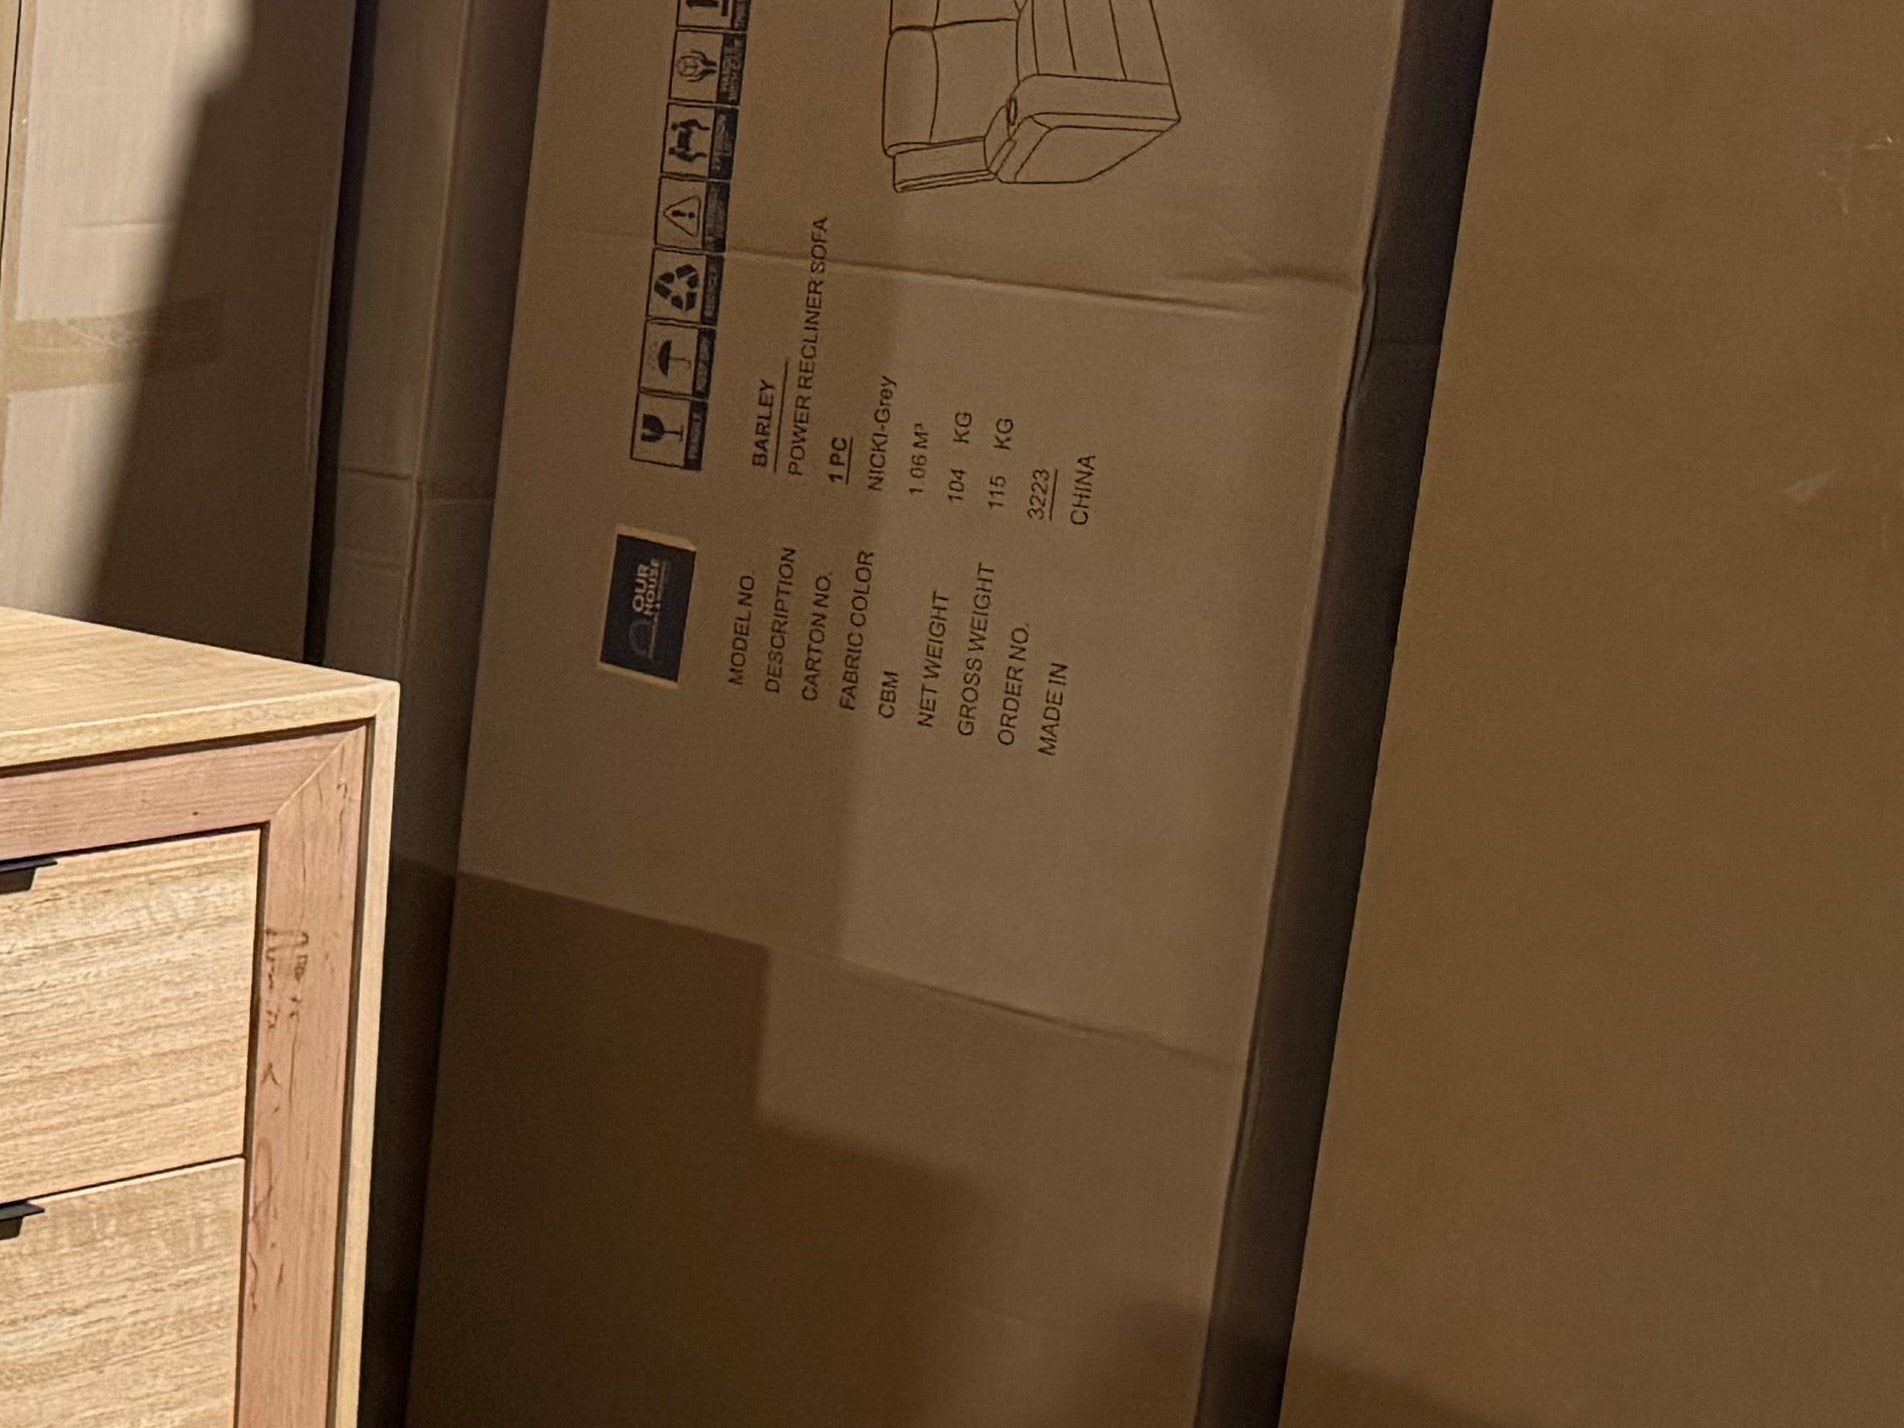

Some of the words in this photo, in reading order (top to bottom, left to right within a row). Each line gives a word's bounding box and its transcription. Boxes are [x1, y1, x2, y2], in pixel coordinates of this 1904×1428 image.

[809, 215, 831, 276] SOFA
[796, 277, 825, 391] RECLINER
[752, 377, 778, 470] BARLEY
[787, 394, 814, 477] POWER
[829, 436, 849, 466] PC
[866, 374, 898, 493] NICKI-Grey
[952, 411, 974, 445] KG
[992, 417, 1016, 452] KG
[946, 468, 967, 503] 104
[987, 474, 1007, 510] 115
[1026, 467, 1049, 521] 3223
[1069, 454, 1097, 527] CHINA
[631, 563, 649, 613] OUR
[643, 557, 661, 617] HOUSE
[763, 545, 797, 695] DESCRIPTION
[812, 569, 834, 609] NO.
[849, 548, 876, 629] COLOR
[966, 561, 995, 653] WEIGHT
[727, 609, 752, 687] MODEL
[800, 608, 828, 703] CARTON
[922, 588, 950, 680] WEIGHT
[1007, 622, 1030, 662] NO.
[838, 630, 865, 712] FABRIC
[877, 670, 899, 720] CBM
[916, 681, 938, 729] NET
[956, 657, 983, 737] GROSS
[996, 664, 1025, 747] ORDER
[1047, 661, 1069, 687] IN
[1036, 688, 1064, 757] MADE
